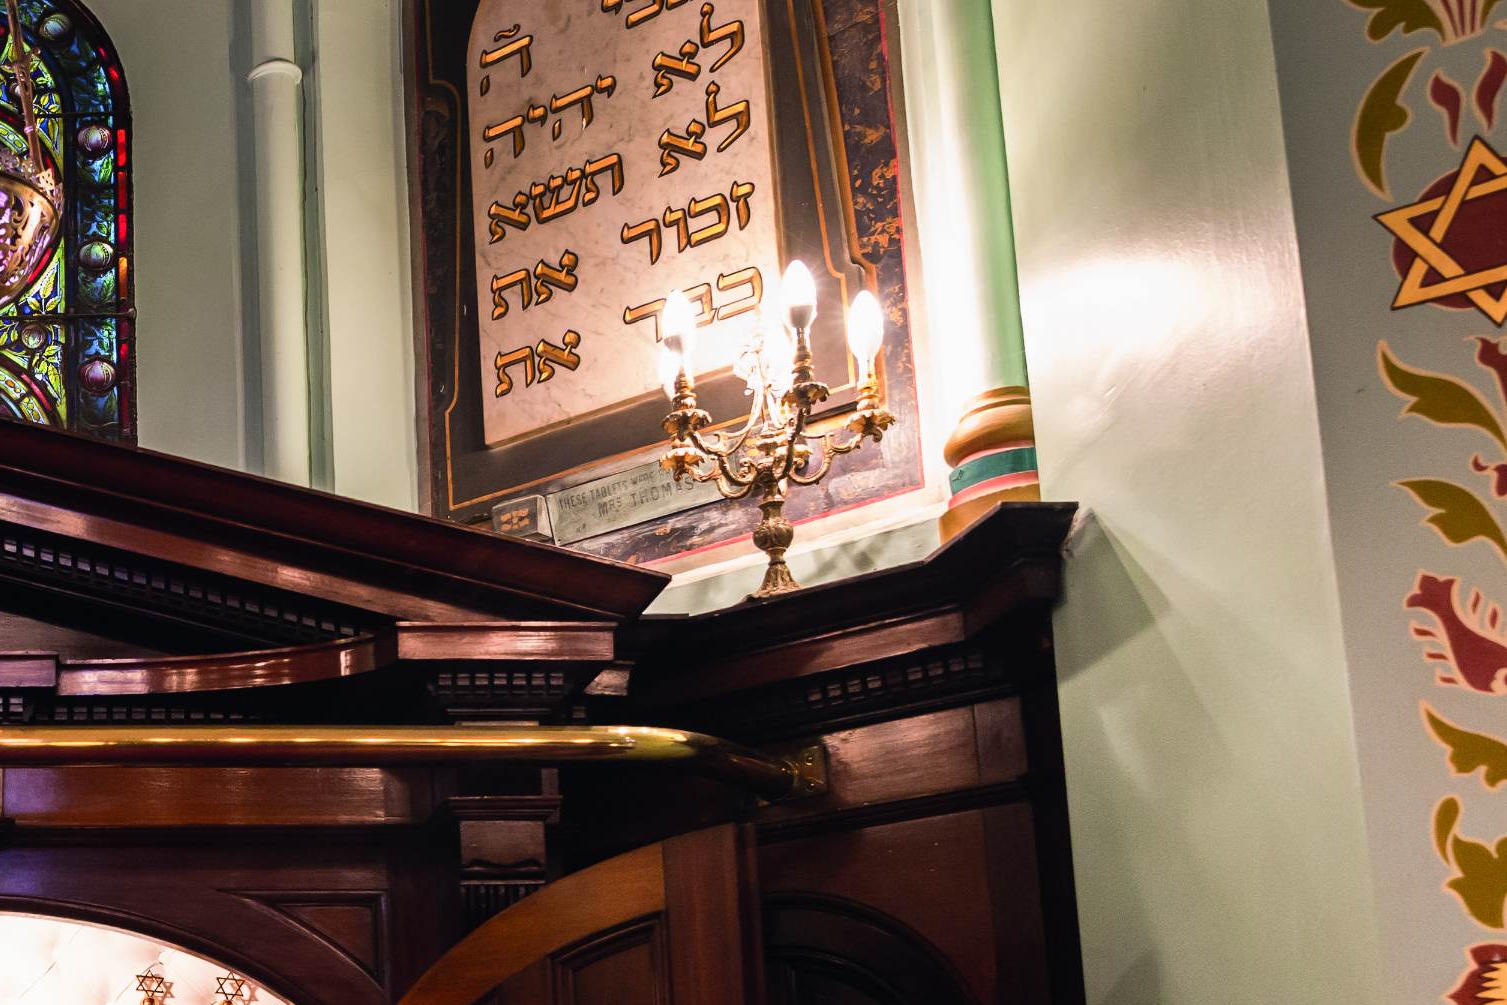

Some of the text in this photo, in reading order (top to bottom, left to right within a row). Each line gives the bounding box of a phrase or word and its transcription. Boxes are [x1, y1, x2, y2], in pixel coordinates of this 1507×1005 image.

[482, 2, 744, 169] לא יהיה
[488, 81, 751, 245] לא תשא
[491, 181, 755, 321] זכור את
[495, 329, 581, 397] את
[558, 494, 587, 510] THESE
[590, 479, 628, 499] TABLETS
[629, 477, 694, 508] THOMAS
